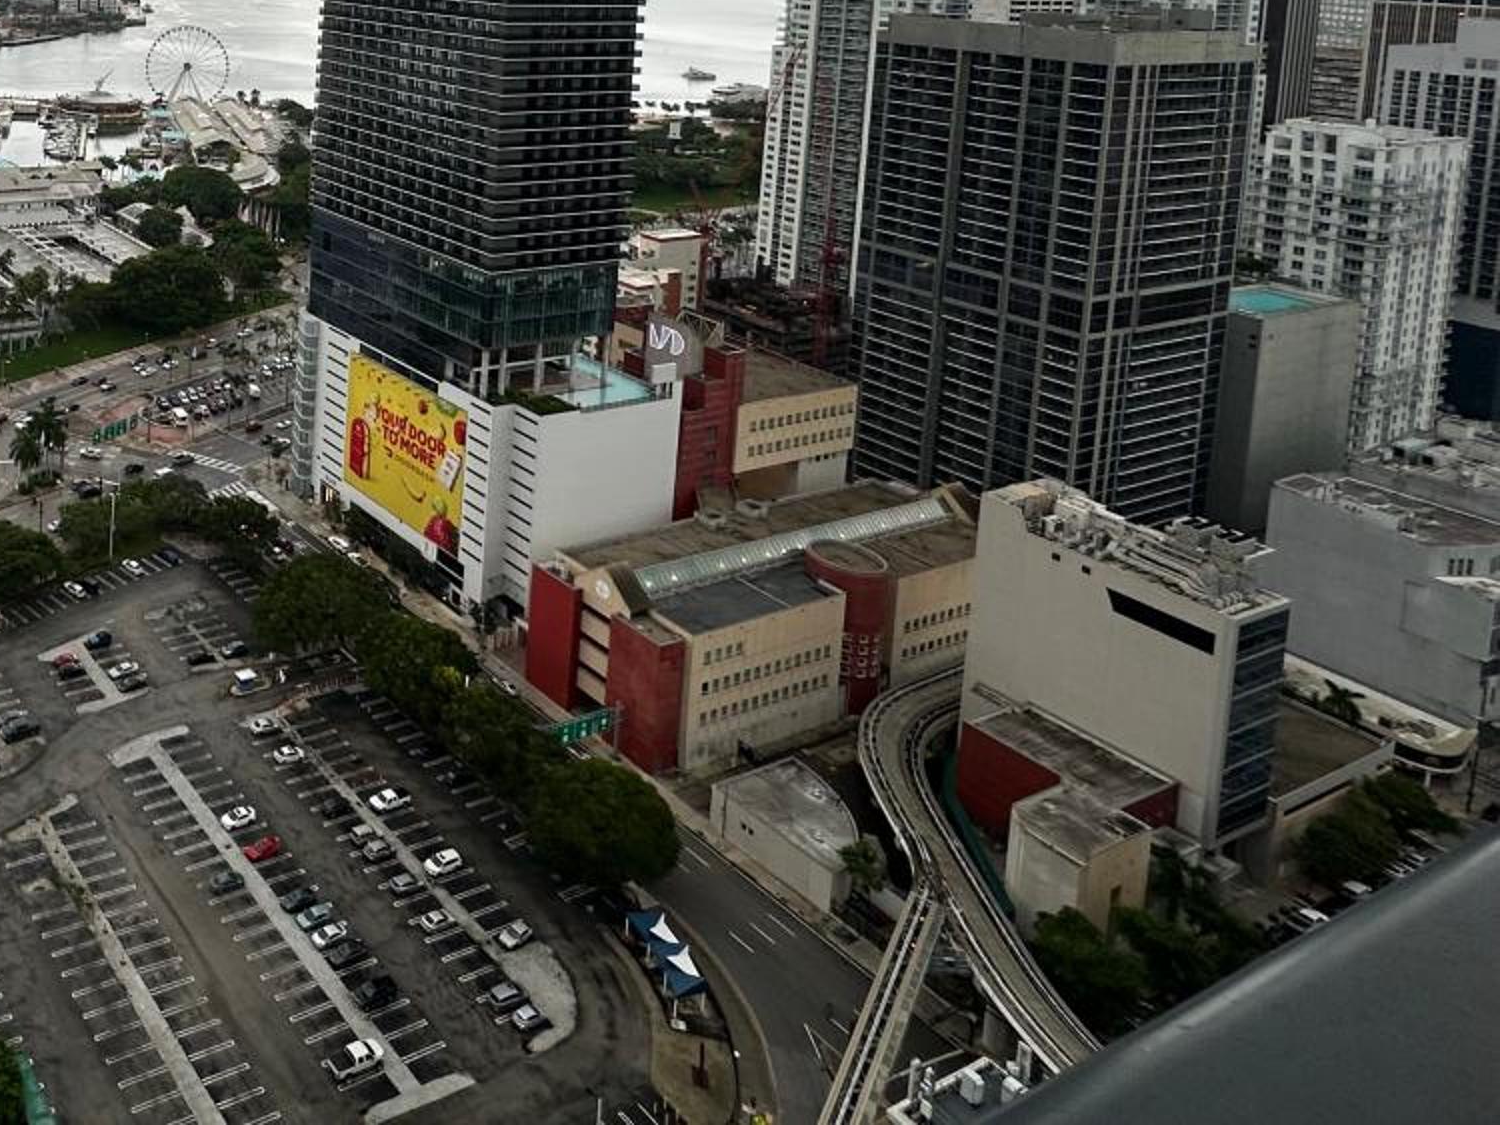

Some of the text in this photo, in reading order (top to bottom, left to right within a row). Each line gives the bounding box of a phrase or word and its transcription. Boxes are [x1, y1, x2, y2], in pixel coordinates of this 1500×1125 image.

[382, 425, 399, 446] TO
[399, 436, 437, 471] MORE
[408, 423, 447, 458] DOOR
